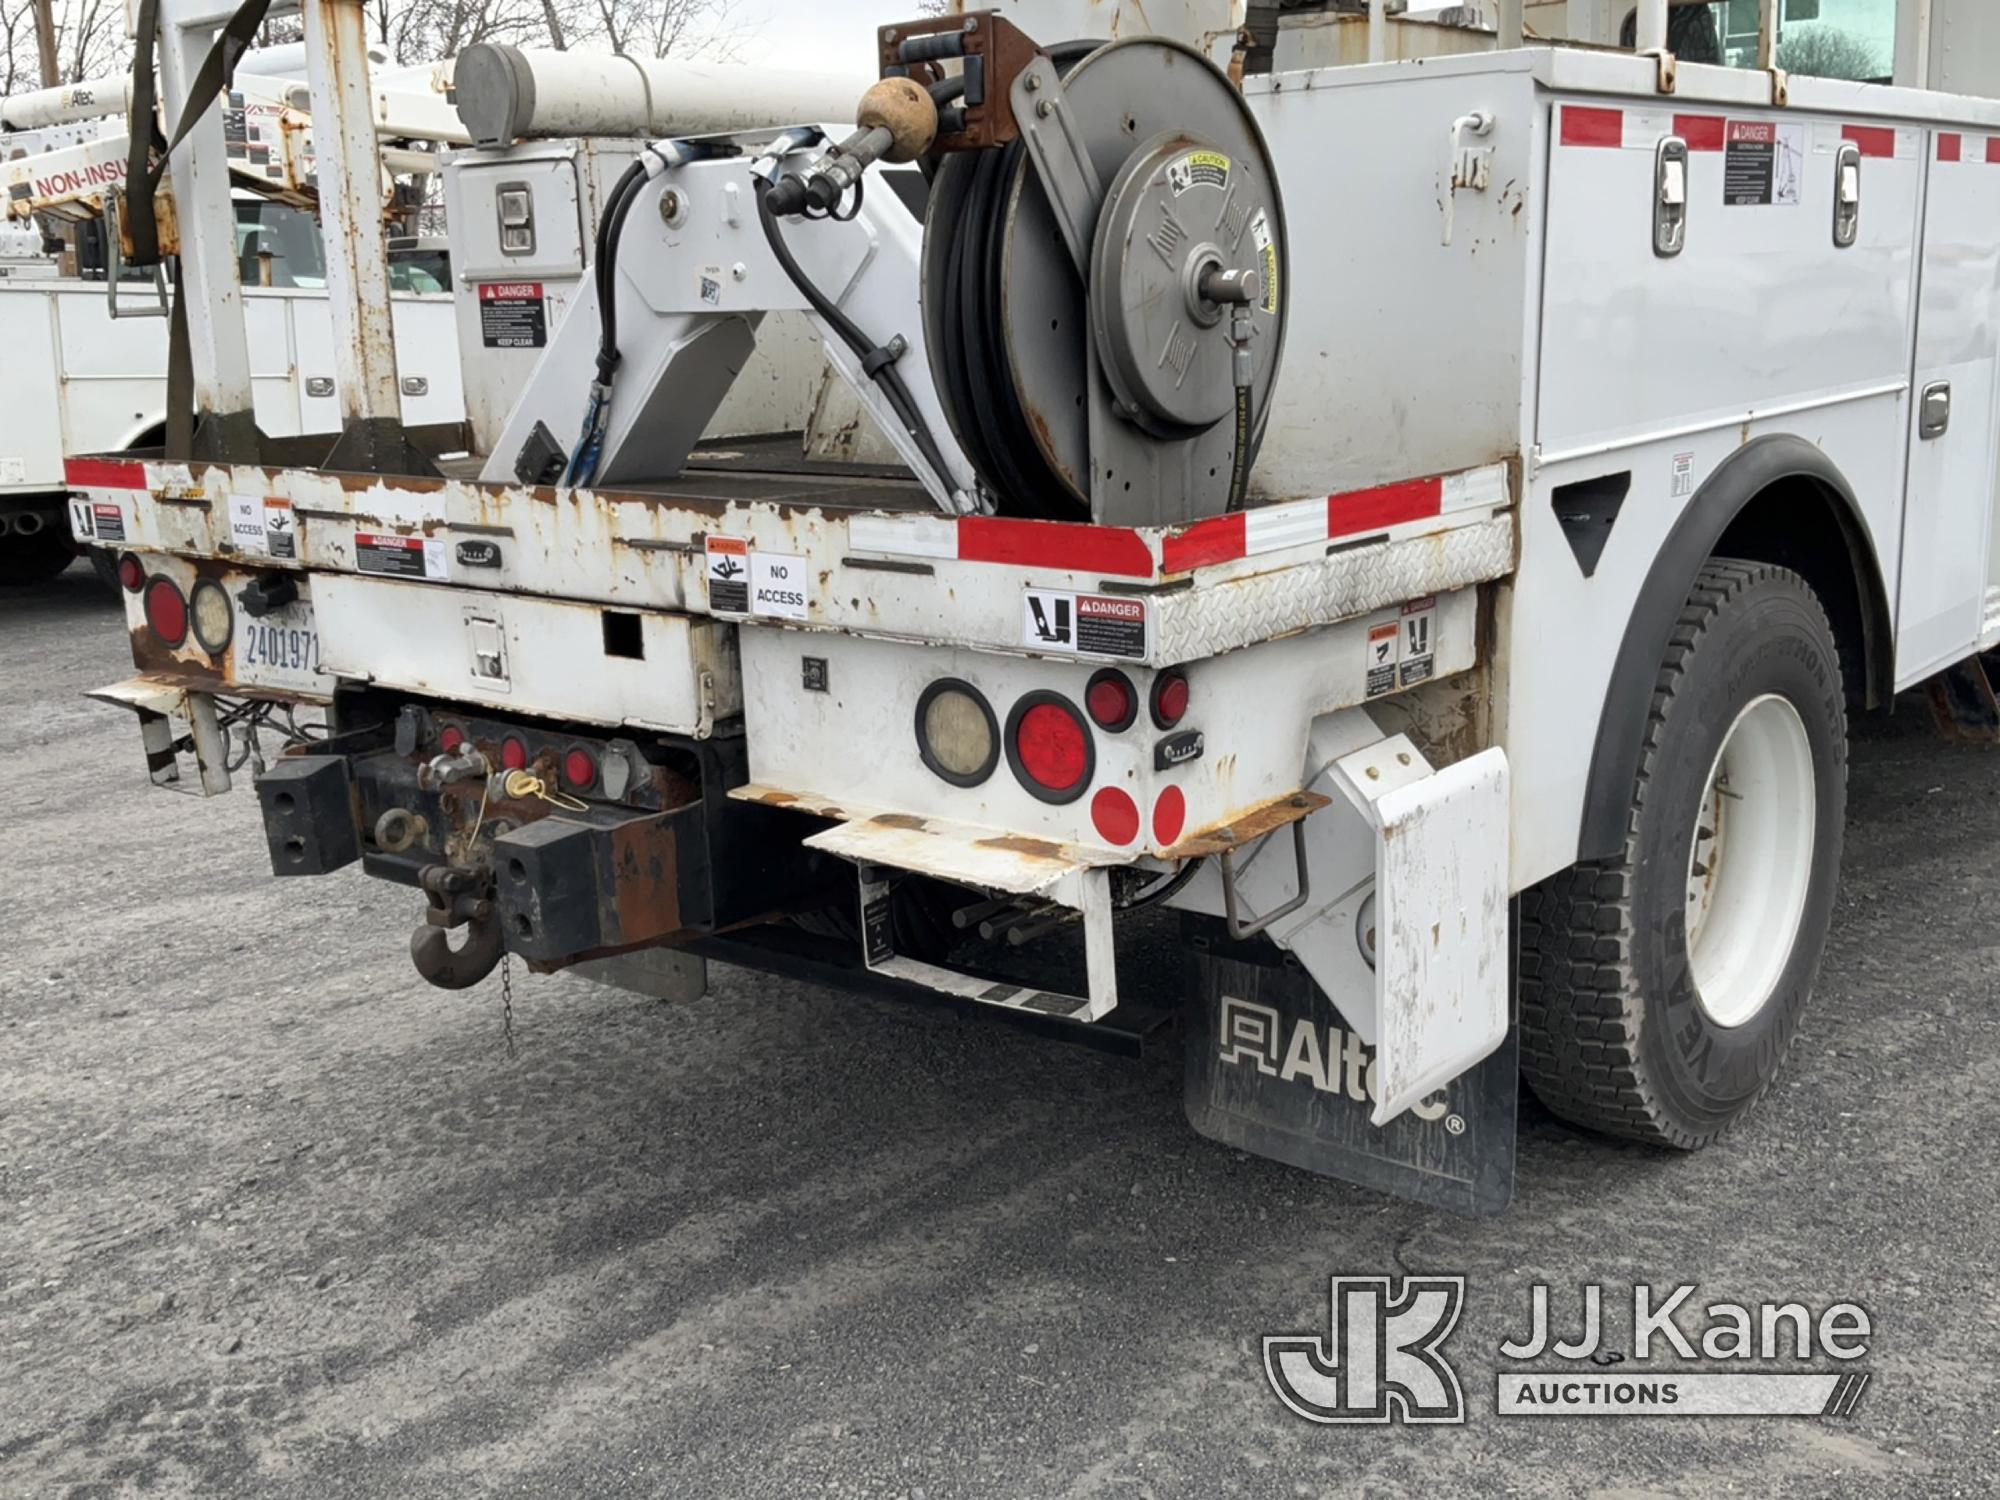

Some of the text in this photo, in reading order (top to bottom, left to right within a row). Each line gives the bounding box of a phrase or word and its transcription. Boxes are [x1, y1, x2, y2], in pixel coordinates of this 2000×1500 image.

[1741, 125, 1768, 140] DANGER
[498, 285, 534, 297] DANGER
[240, 505, 252, 515] NO
[234, 524, 263, 536] ACCESS
[770, 565, 788, 579] NO
[757, 589, 804, 606] ACCESS
[1092, 601, 1140, 616] DANGER
